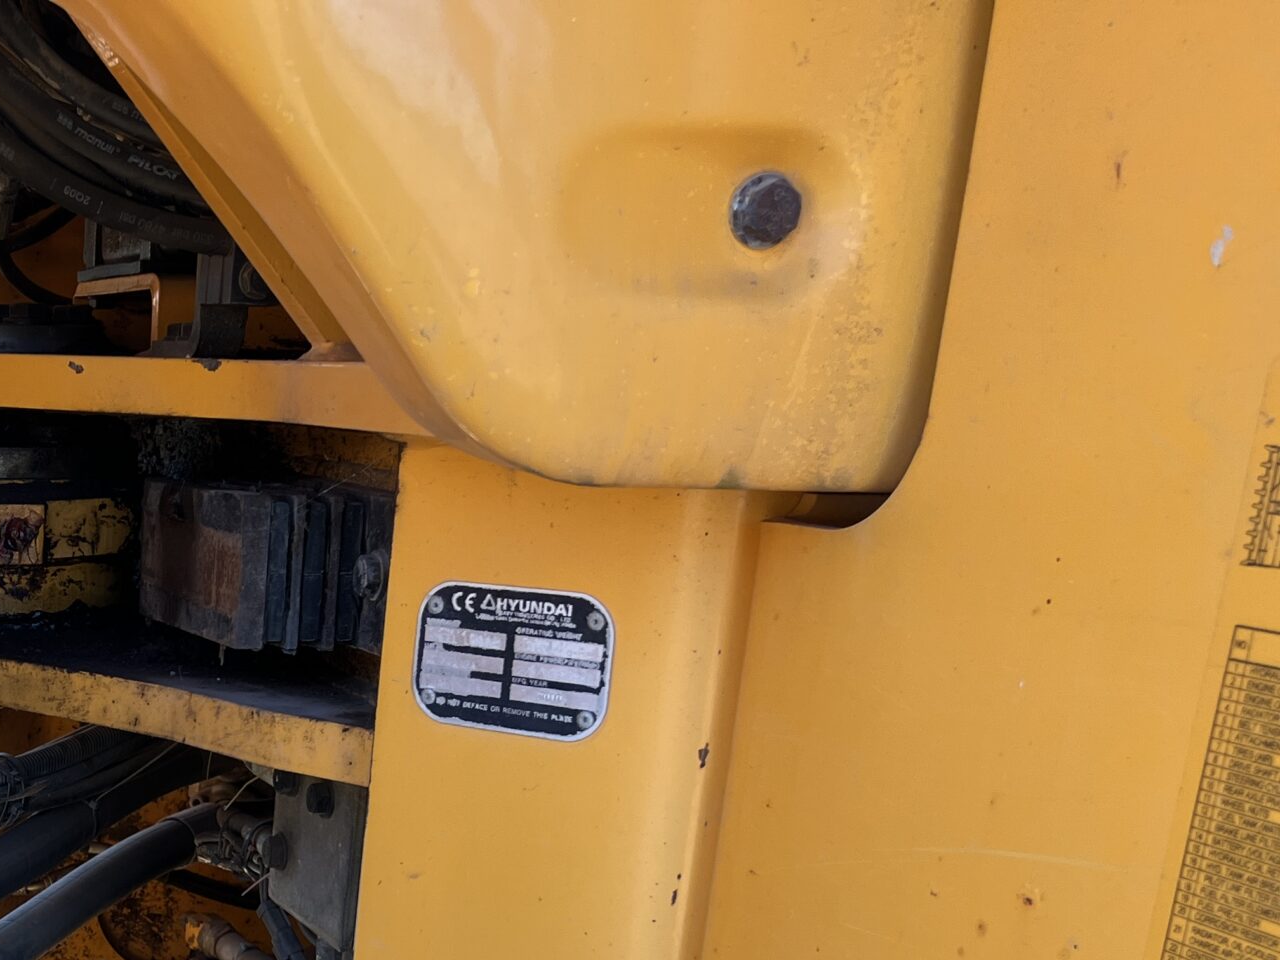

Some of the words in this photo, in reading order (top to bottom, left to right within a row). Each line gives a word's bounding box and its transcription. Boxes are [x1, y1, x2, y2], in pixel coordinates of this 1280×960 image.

[496, 598, 574, 617] HYUNDAI
[462, 701, 488, 712] DEFACE
[502, 707, 530, 718] REMOVE
[533, 711, 548, 720] THIS
